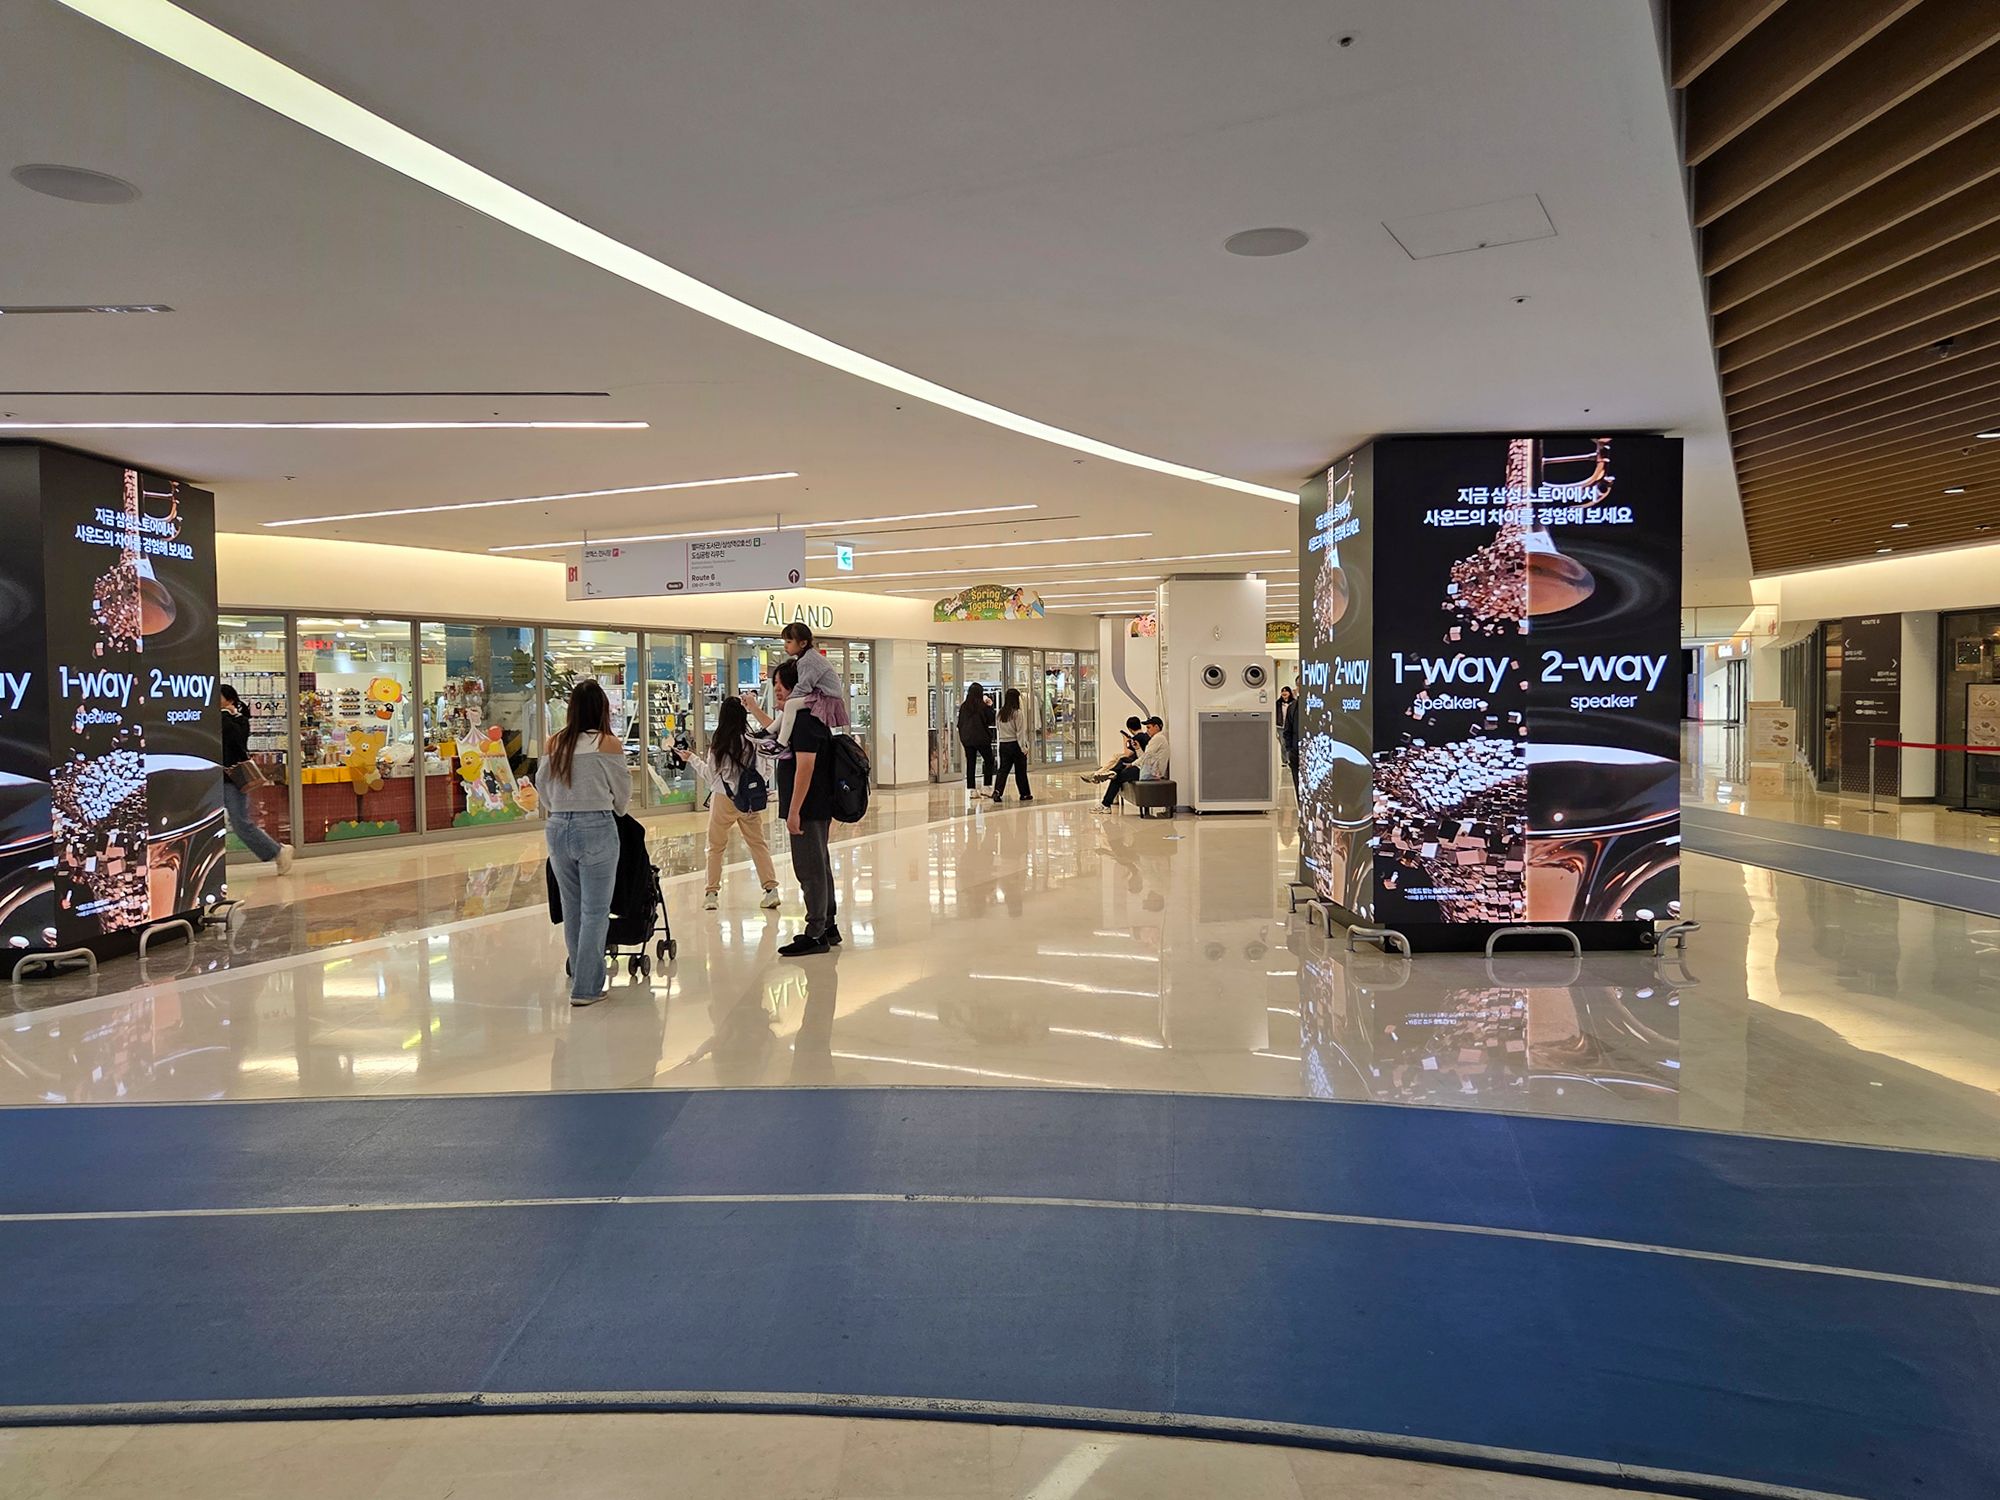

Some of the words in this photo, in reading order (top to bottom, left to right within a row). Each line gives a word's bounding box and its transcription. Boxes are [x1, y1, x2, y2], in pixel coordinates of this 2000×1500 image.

[1458, 487, 1489, 504] 지금
[95, 507, 114, 526] 지금
[1423, 508, 1486, 526] 사운드의
[1488, 507, 1535, 525] 차이를
[1538, 507, 1583, 525] 경험해
[1585, 506, 1634, 524] 보세요
[75, 524, 114, 547] 사운드의
[115, 531, 141, 552] 차이를
[143, 536, 168, 556] 경험해
[169, 542, 194, 560] 보세요
[568, 566, 578, 582] B1
[971, 588, 1001, 602] Spring
[766, 594, 834, 628] ÅLAND
[968, 600, 1004, 612] Together
[1302, 659, 1329, 694] 1-way
[1335, 656, 1369, 695] 2-way
[1391, 653, 1510, 693] 1-way
[1541, 650, 1668, 691] 2-way
[59, 666, 134, 708] 1-way
[150, 668, 215, 707] 2-way
[1414, 694, 1480, 711] speaker
[1570, 693, 1638, 712] speaker
[75, 709, 118, 726] speaker
[166, 708, 202, 725] speaker
